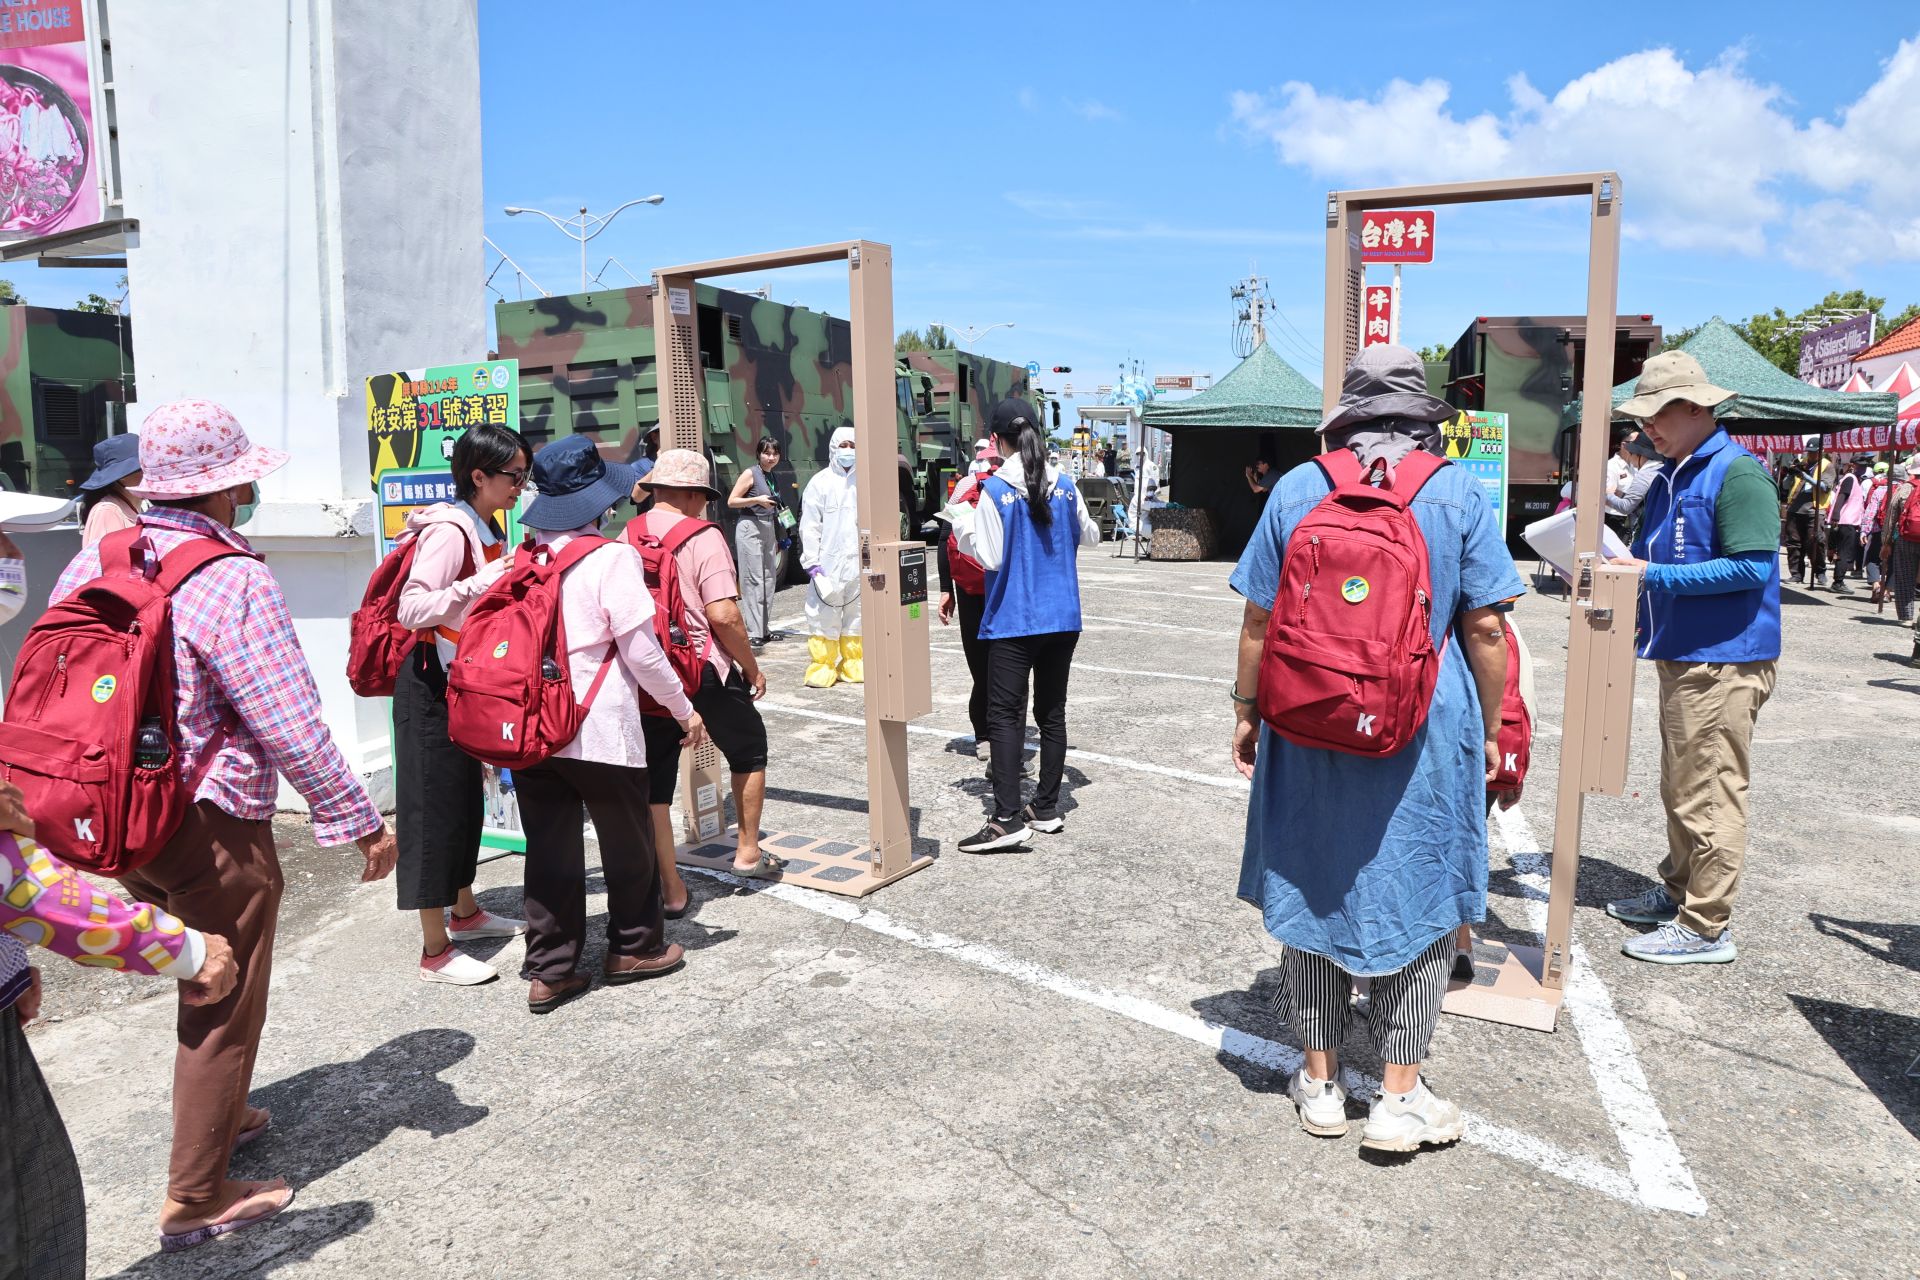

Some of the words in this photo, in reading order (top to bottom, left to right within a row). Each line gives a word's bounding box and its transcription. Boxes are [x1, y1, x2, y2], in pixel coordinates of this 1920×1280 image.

[16, 6, 71, 32] HOUSE
[1361, 218, 1430, 249] 台灣牛
[372, 394, 508, 433] 核安第31號演習
[503, 722, 515, 742] K
[1356, 713, 1377, 736] K
[1504, 752, 1518, 772] K
[74, 818, 97, 842] K
